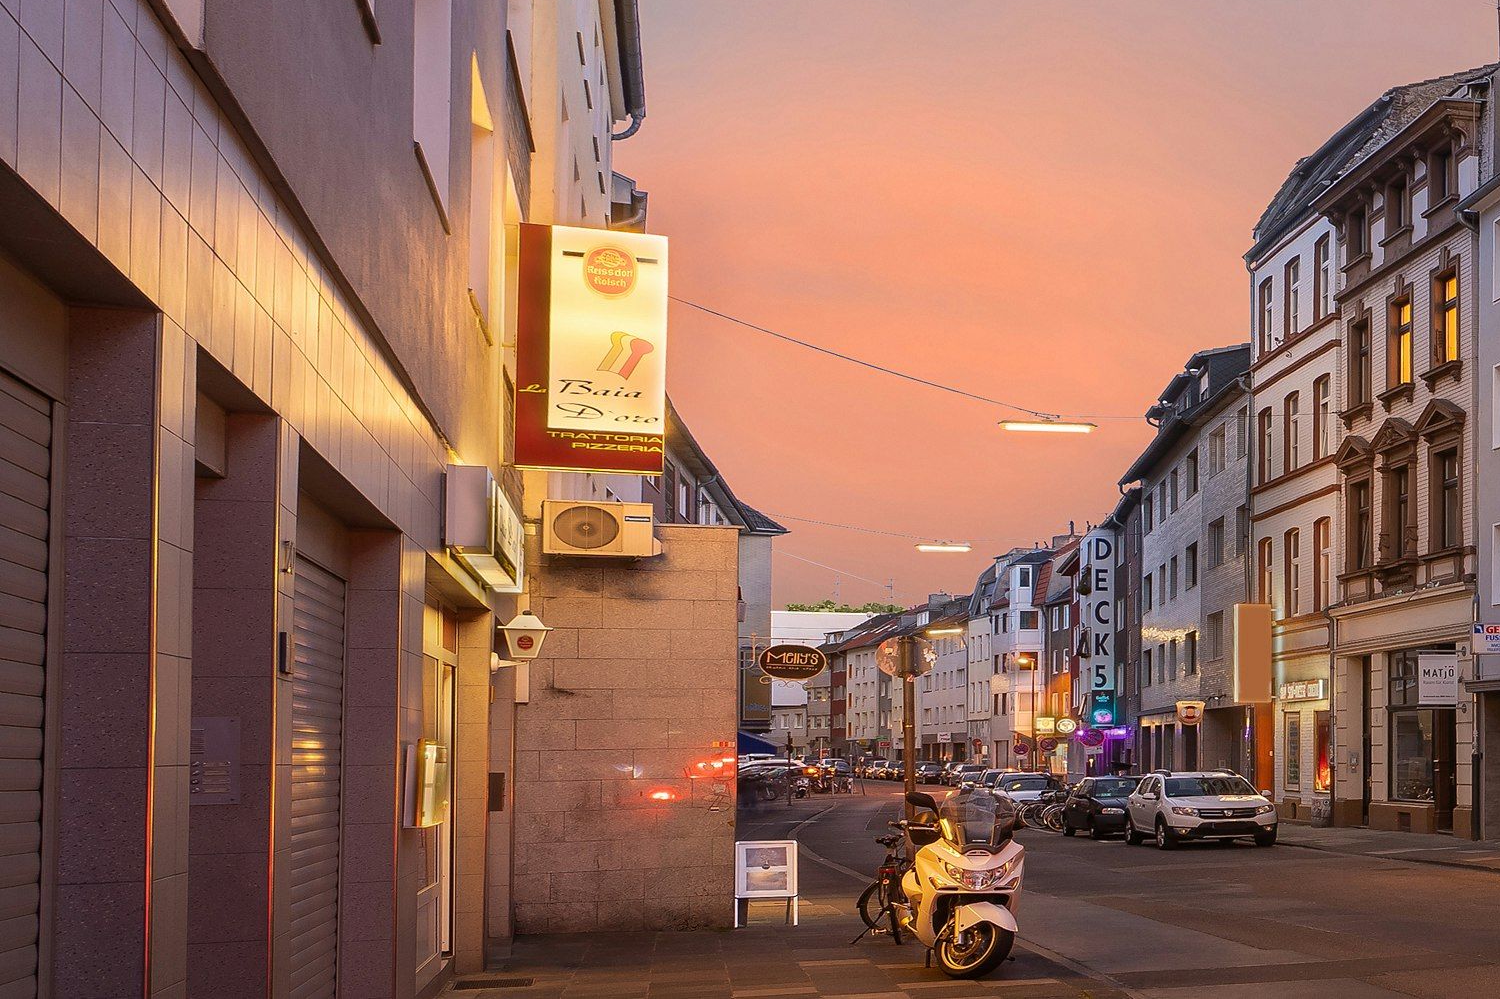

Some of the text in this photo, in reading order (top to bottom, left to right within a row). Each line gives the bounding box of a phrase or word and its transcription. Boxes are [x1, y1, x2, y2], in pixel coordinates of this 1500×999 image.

[558, 379, 644, 399] Baia
[547, 431, 663, 444] TRATTORIA
[571, 442, 664, 453] PIZZERIA
